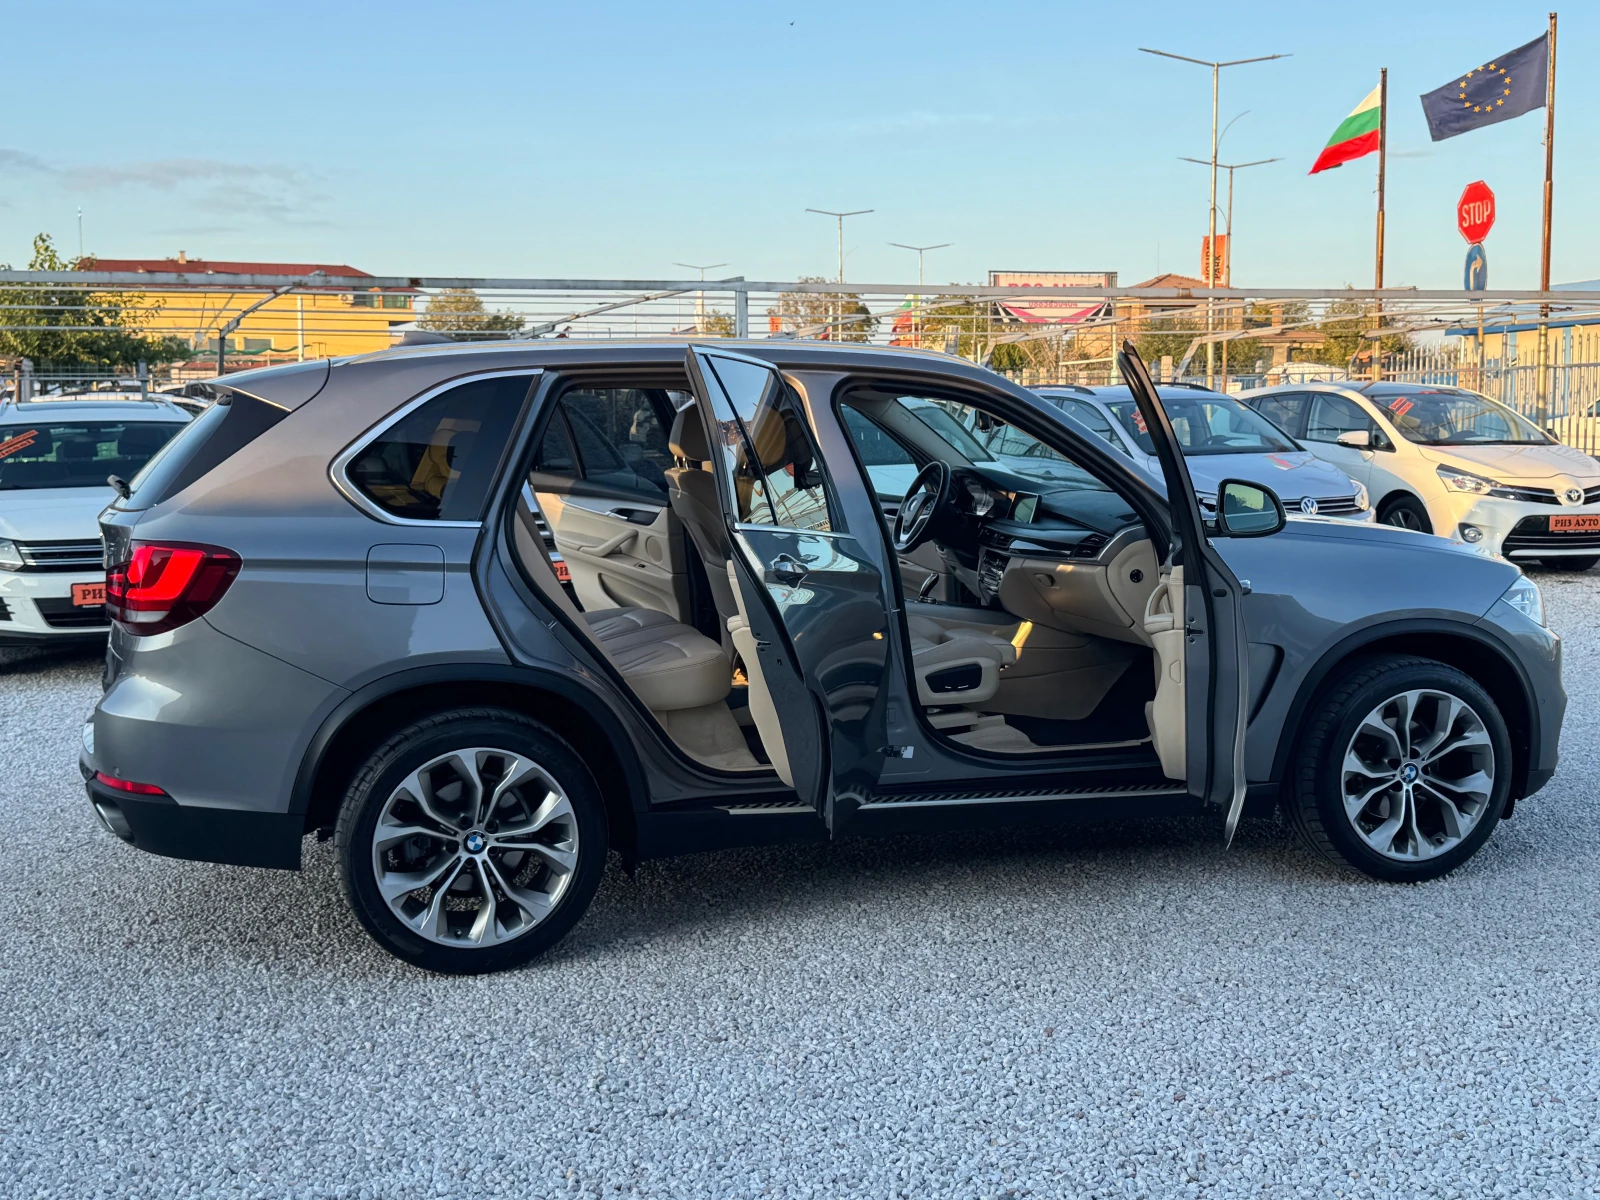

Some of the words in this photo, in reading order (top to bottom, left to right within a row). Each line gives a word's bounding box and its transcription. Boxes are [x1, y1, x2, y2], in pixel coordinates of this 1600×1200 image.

[1462, 200, 1491, 227] STOP
[1574, 518, 1599, 527] АУТО
[81, 588, 106, 600] РИ
